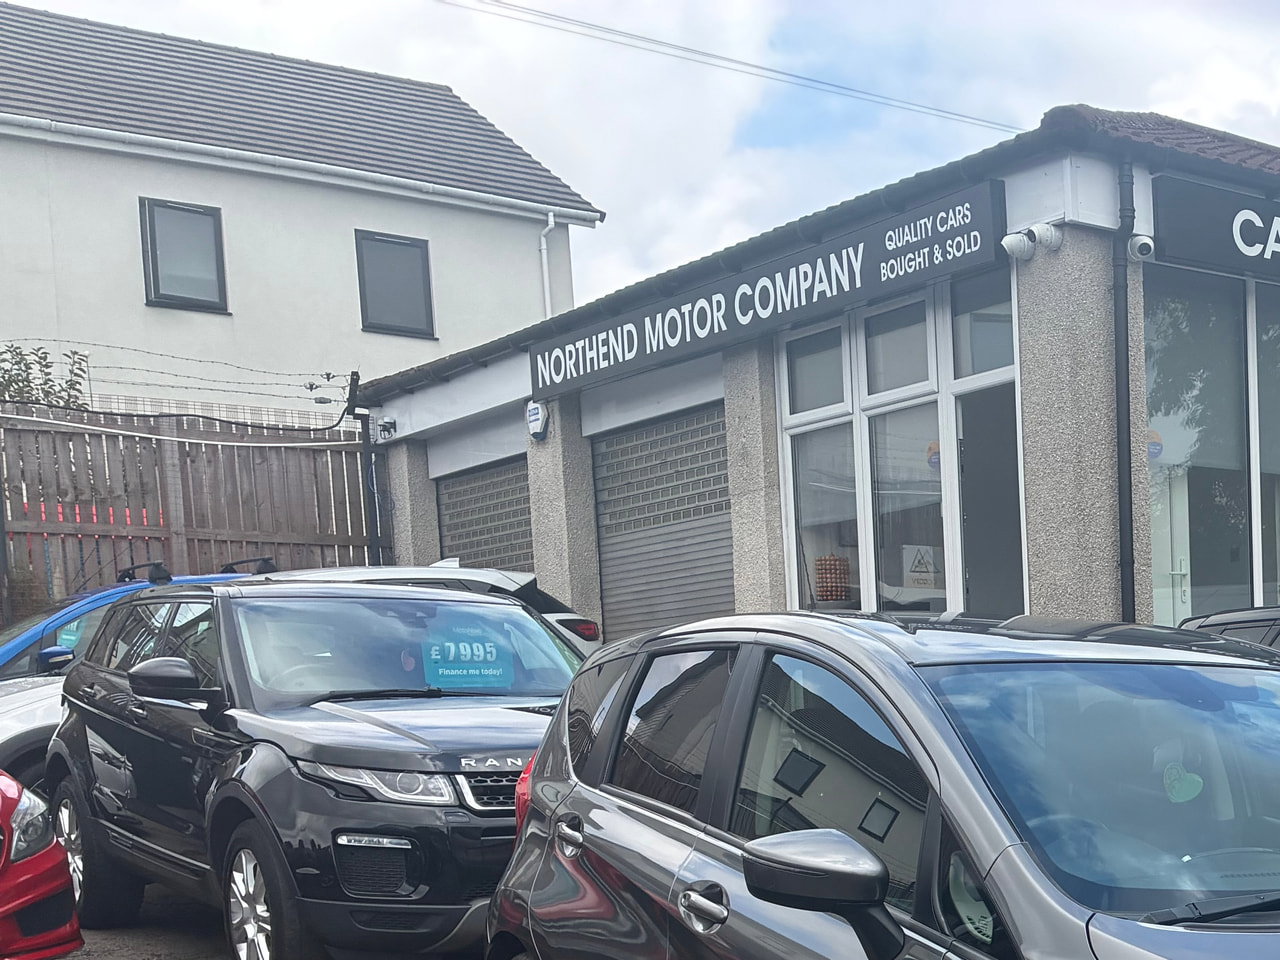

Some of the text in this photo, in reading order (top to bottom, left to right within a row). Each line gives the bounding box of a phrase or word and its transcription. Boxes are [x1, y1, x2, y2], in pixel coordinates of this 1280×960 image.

[885, 202, 972, 251] QUALITY CARS
[880, 230, 981, 282] BOUGHT & SOLD
[536, 242, 865, 388] NORTHEND MOTOR COMPANY
[481, 668, 503, 676] today!
